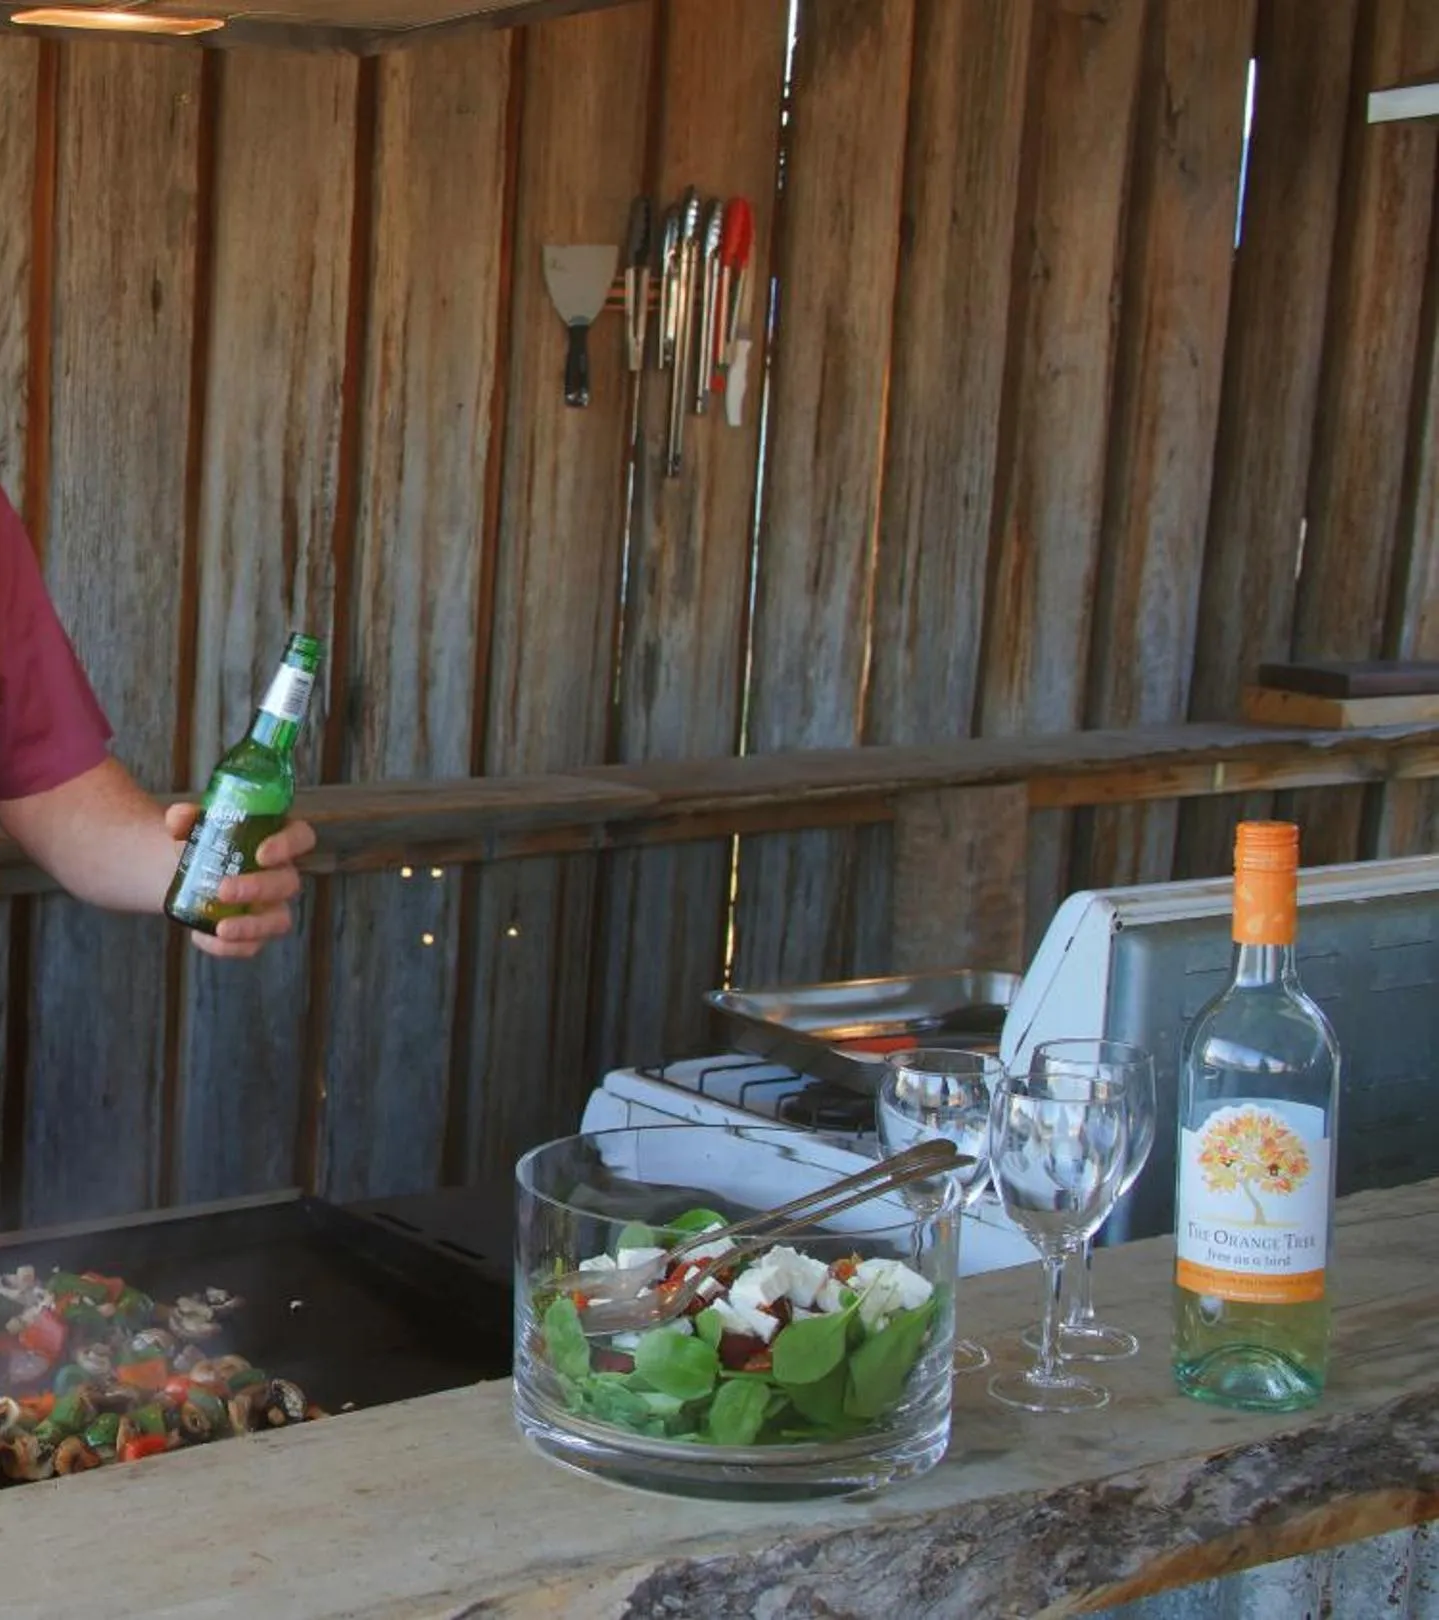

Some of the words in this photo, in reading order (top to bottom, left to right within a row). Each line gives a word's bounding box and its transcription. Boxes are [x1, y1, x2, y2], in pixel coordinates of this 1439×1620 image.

[1205, 1248, 1231, 1261] free
[1233, 1254, 1250, 1265] as
[1252, 1256, 1261, 1265] a
